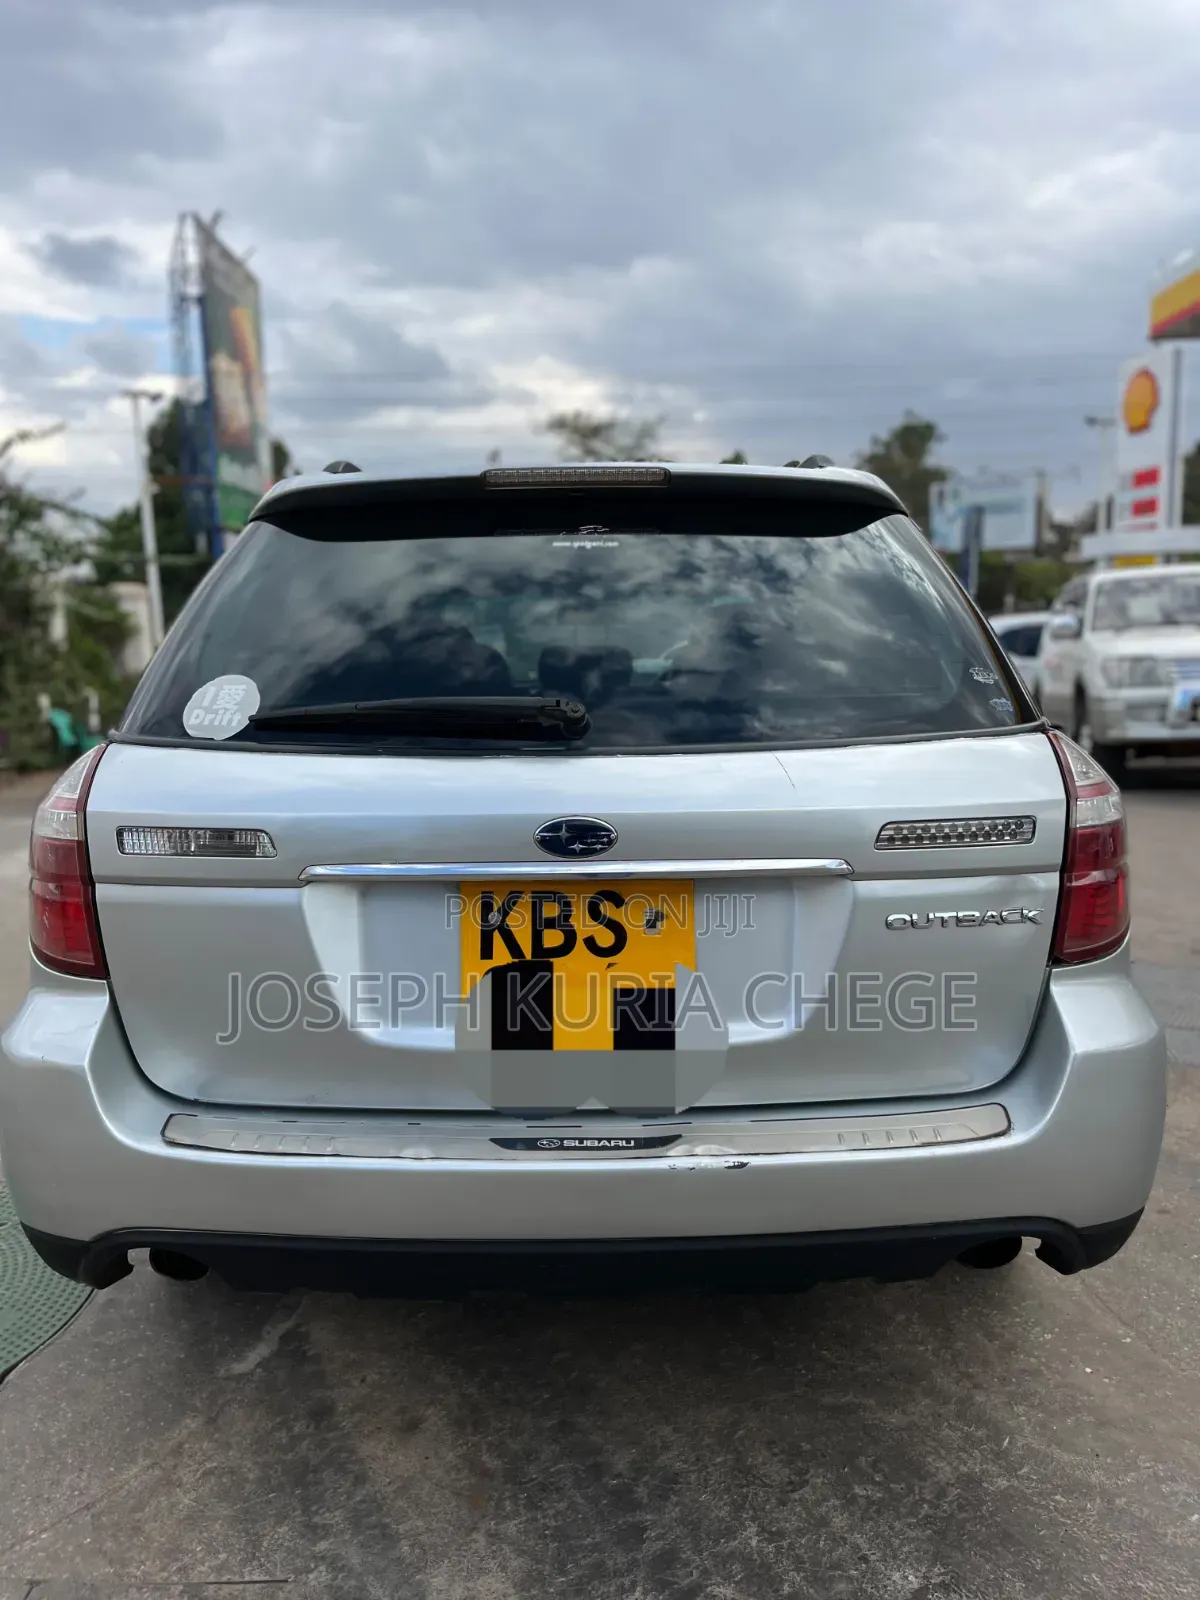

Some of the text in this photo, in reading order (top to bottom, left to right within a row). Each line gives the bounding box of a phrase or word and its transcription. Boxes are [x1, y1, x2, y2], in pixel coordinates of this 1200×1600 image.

[188, 708, 242, 727] Drift
[479, 889, 628, 960] KBS
[885, 907, 1044, 930] OUTBACK
[563, 1139, 634, 1147] SUBARU
